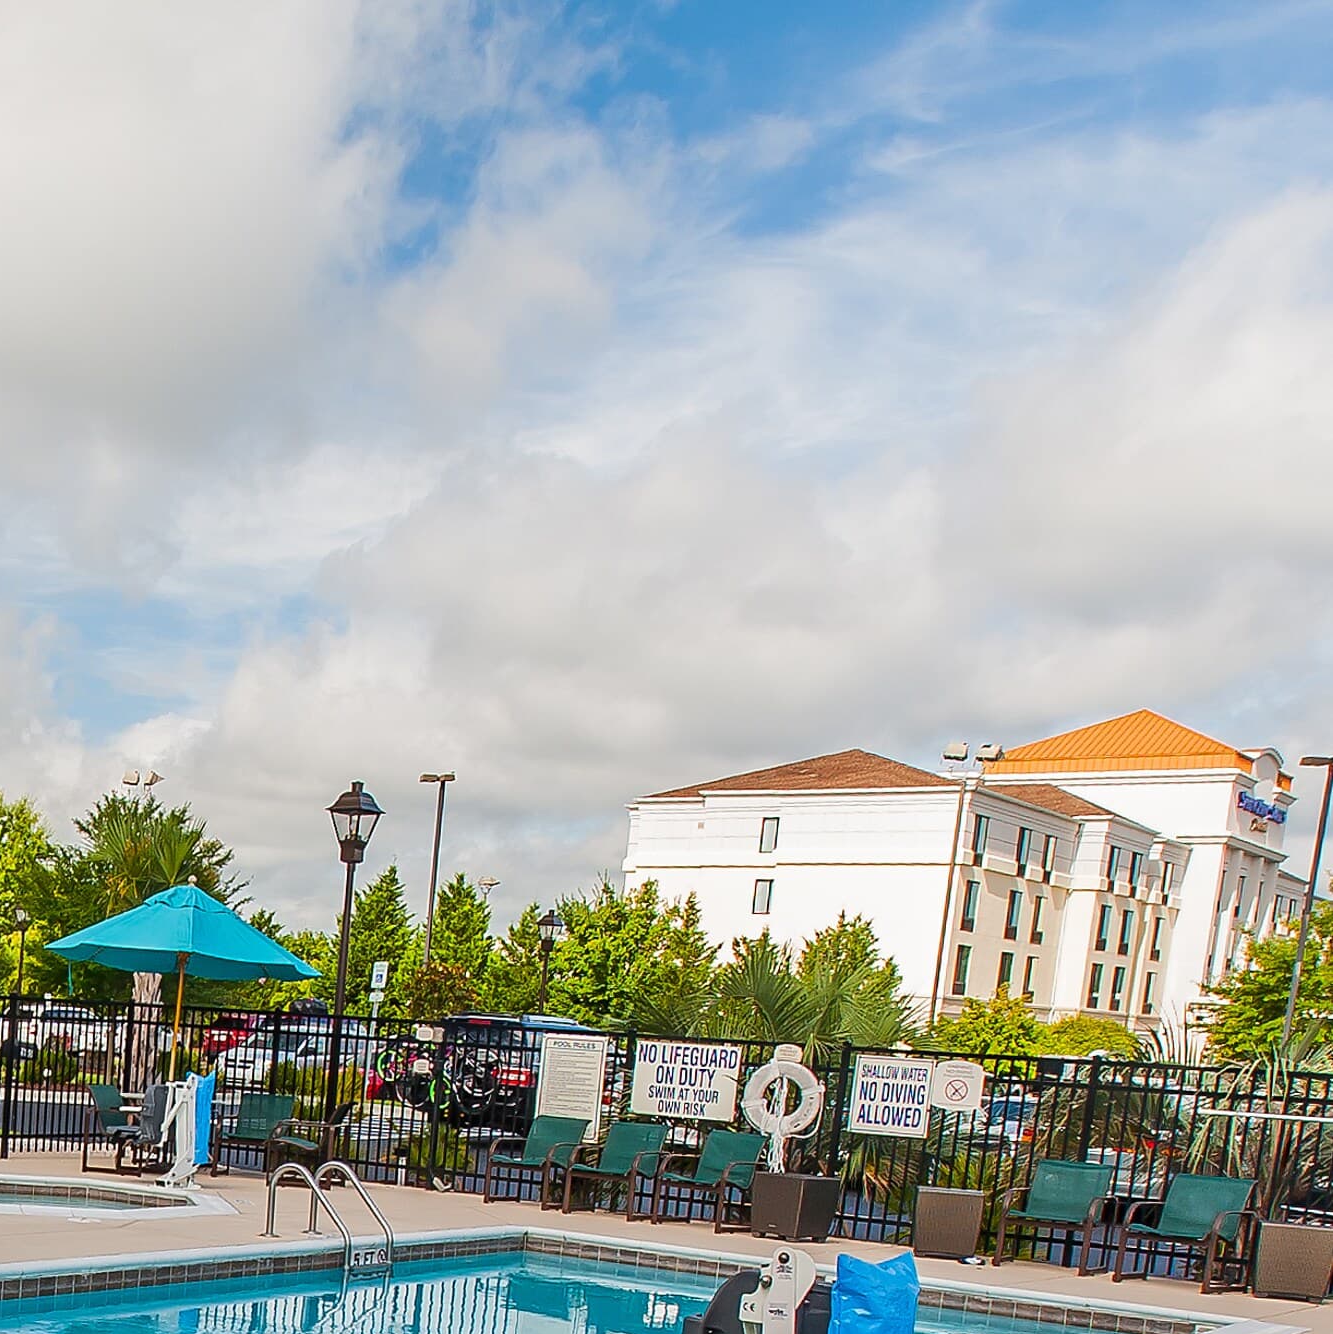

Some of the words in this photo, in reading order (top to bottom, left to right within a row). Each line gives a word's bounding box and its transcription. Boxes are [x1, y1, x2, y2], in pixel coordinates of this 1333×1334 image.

[553, 1040, 571, 1048] POOL
[638, 1043, 658, 1063] NO
[661, 1045, 738, 1069] LIFEGUARD
[656, 1065, 675, 1085] ON
[679, 1067, 716, 1088] DUTY
[861, 1063, 899, 1080] SHALLOW
[901, 1067, 928, 1082] WATER
[648, 1085, 676, 1099] SWIM
[677, 1088, 690, 1101] AT
[692, 1089, 719, 1104] YOUR
[859, 1080, 878, 1102] NO
[881, 1082, 926, 1105] DIVING
[658, 1100, 681, 1113] OWN
[683, 1102, 706, 1116] RISK
[856, 1103, 922, 1128] ALLOWED
